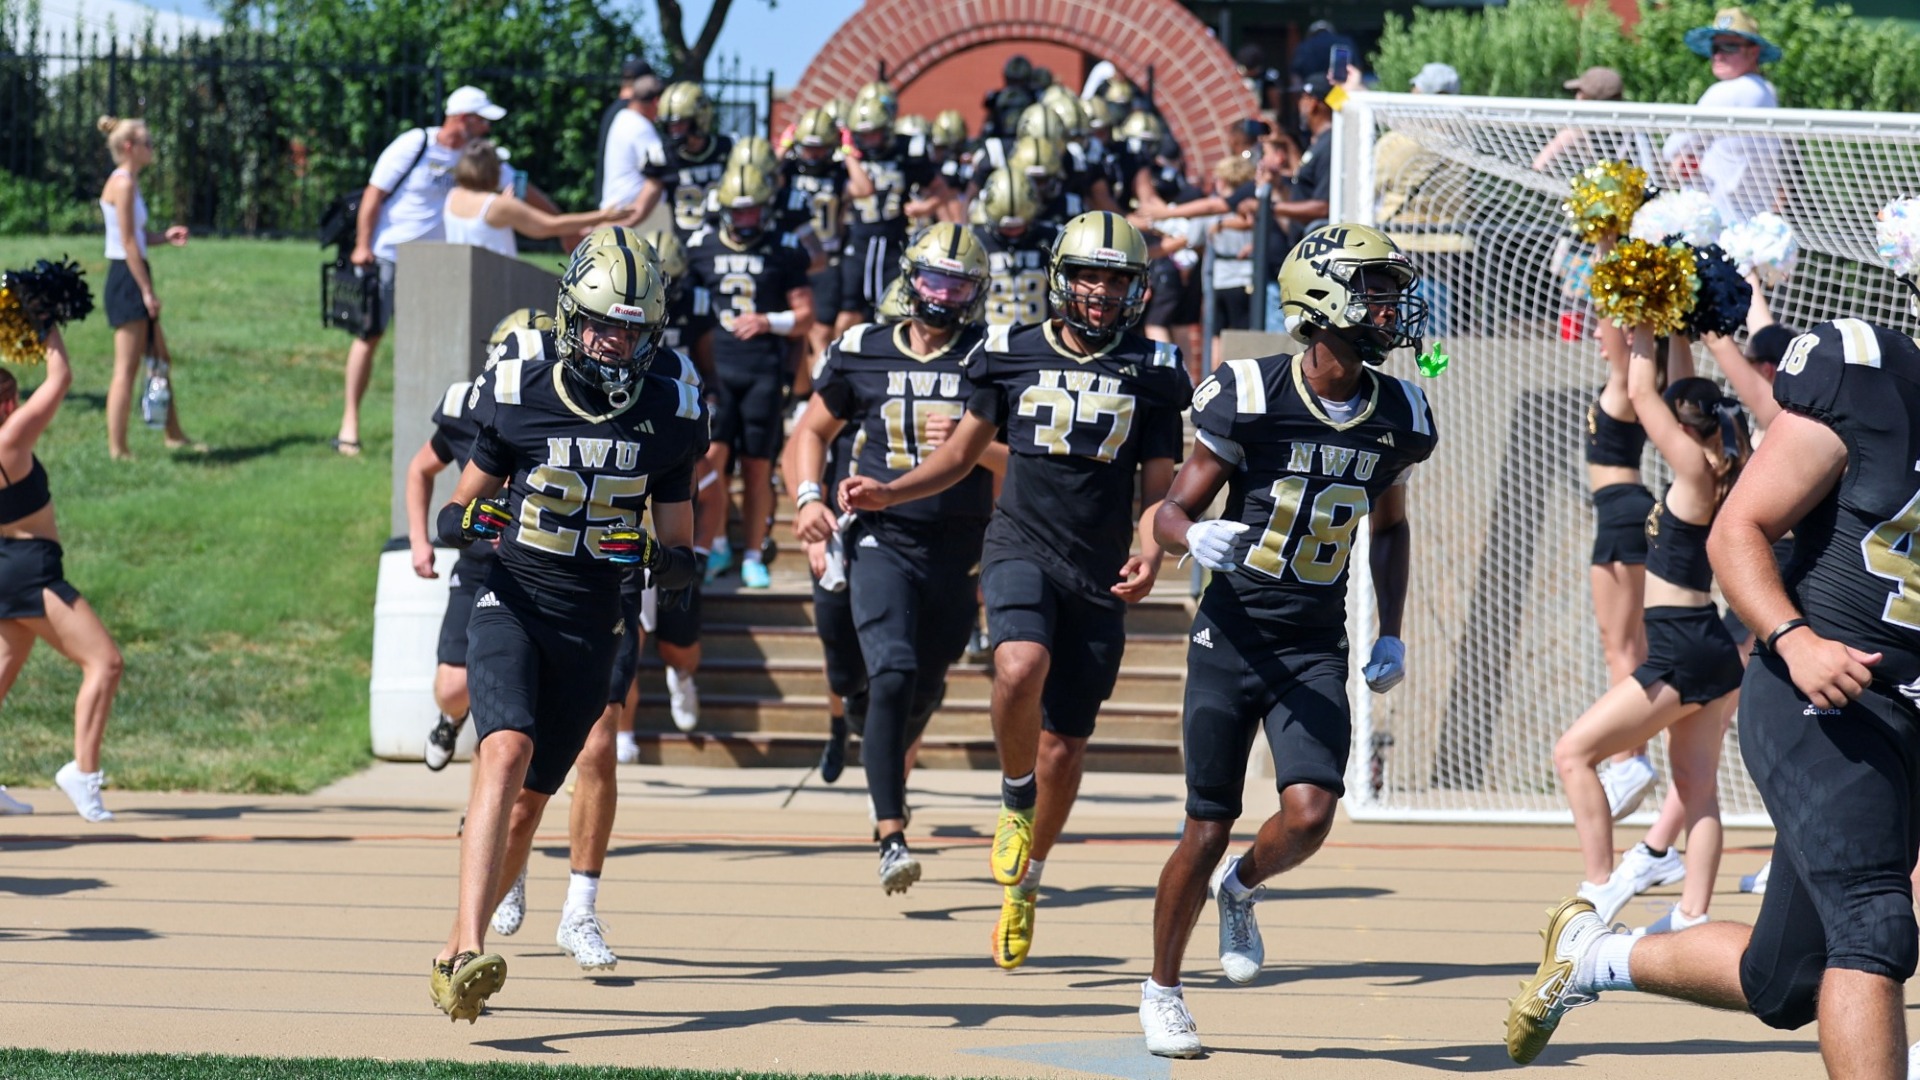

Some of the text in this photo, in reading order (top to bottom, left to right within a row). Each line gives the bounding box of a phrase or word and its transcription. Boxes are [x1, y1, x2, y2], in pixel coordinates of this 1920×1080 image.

[614, 306, 643, 318] Riddell
[719, 273, 756, 332] 3
[886, 371, 961, 398] NWU
[1039, 369, 1123, 395] NWU
[1017, 385, 1136, 463] 37
[547, 437, 641, 471] NWU
[1287, 442, 1381, 482] NWU
[516, 463, 649, 559] 25
[1243, 475, 1370, 585] 18
